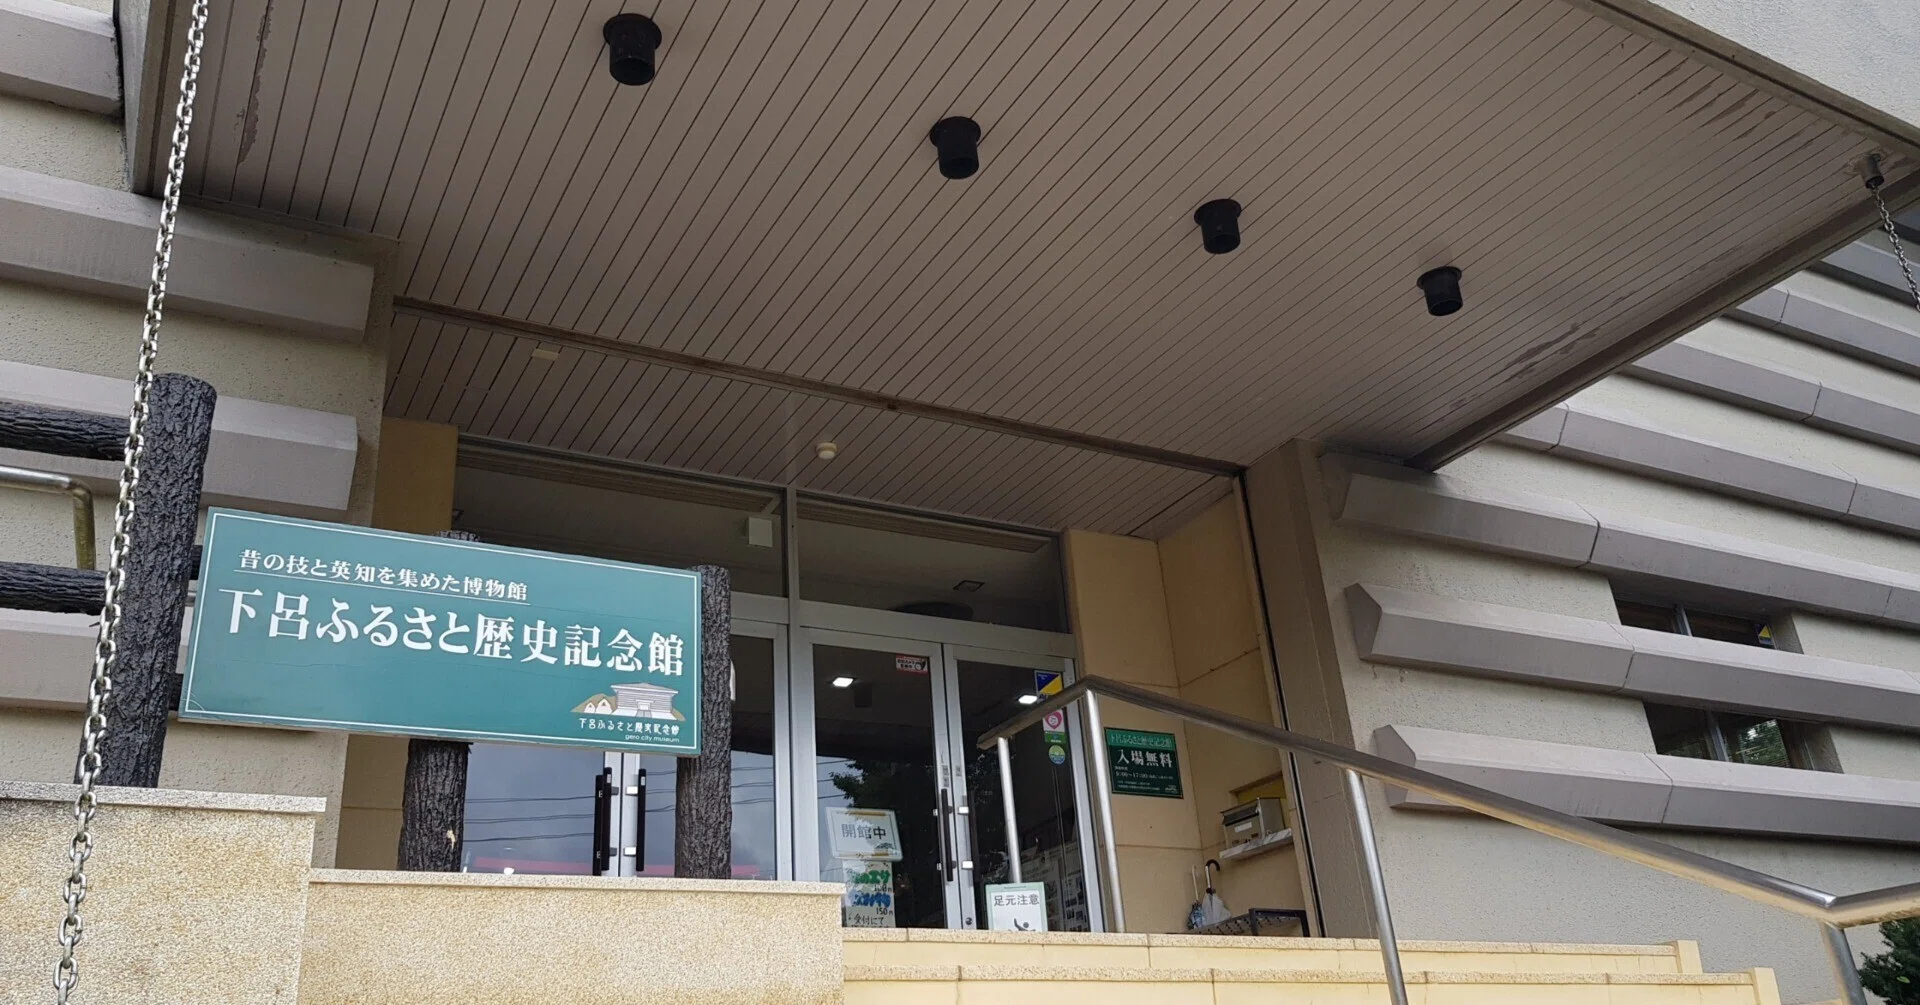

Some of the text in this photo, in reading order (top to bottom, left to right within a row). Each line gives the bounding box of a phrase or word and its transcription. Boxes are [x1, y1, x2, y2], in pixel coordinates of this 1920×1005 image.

[239, 549, 529, 601] 昔の技と英知を集めた博物館
[218, 588, 684, 676] 下呂ふるさと歴史記念館
[1117, 749, 1173, 768] 入場無料
[841, 824, 886, 840] 開館中
[993, 893, 1040, 907] 足元注意
